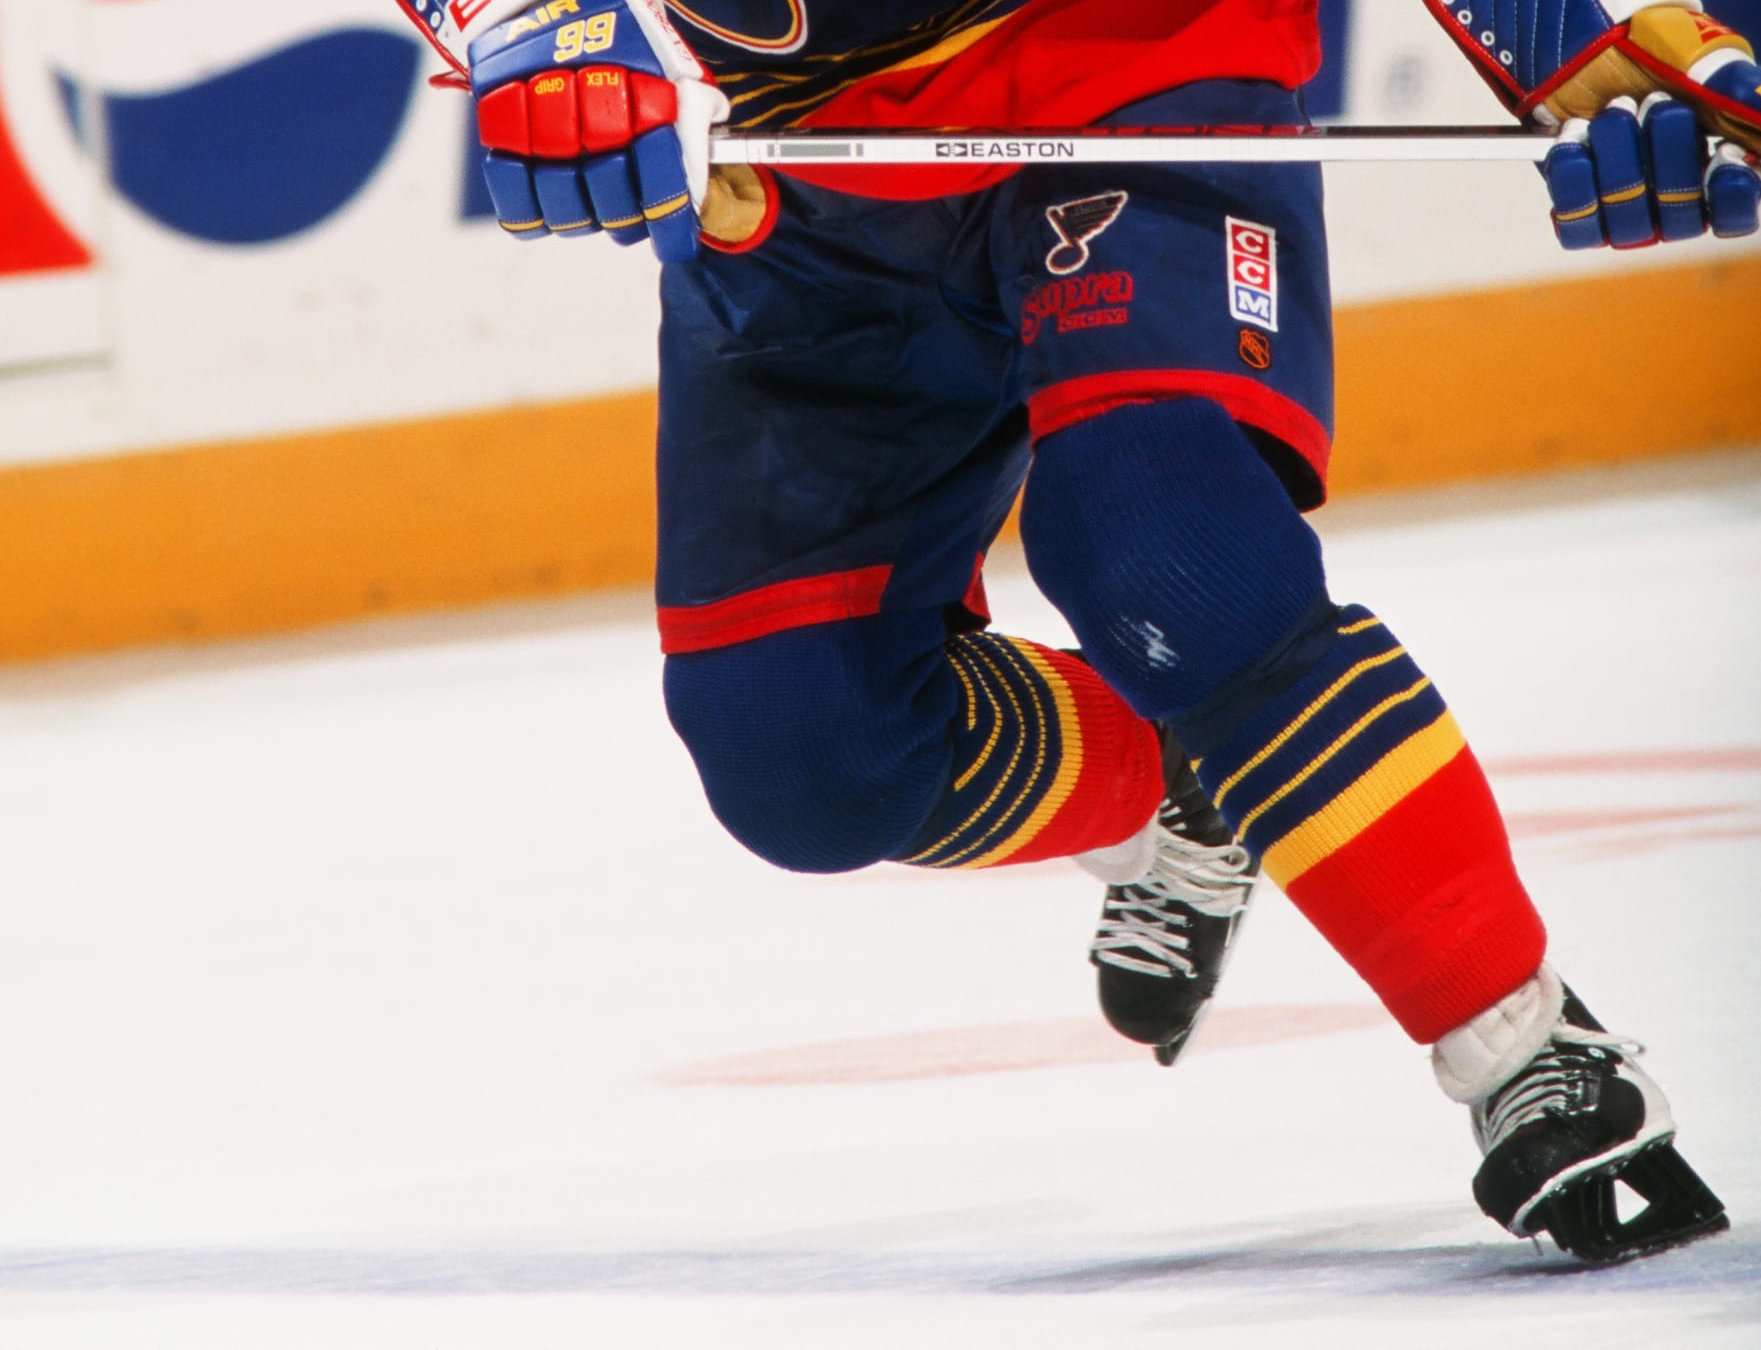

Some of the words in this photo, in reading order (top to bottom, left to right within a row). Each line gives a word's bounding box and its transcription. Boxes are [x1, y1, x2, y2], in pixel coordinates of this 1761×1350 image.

[553, 11, 616, 63] 99
[534, 77, 565, 95] GRIP
[586, 71, 620, 87] FLEX
[971, 142, 1074, 158] EASTON
[1235, 230, 1271, 320] CCM
